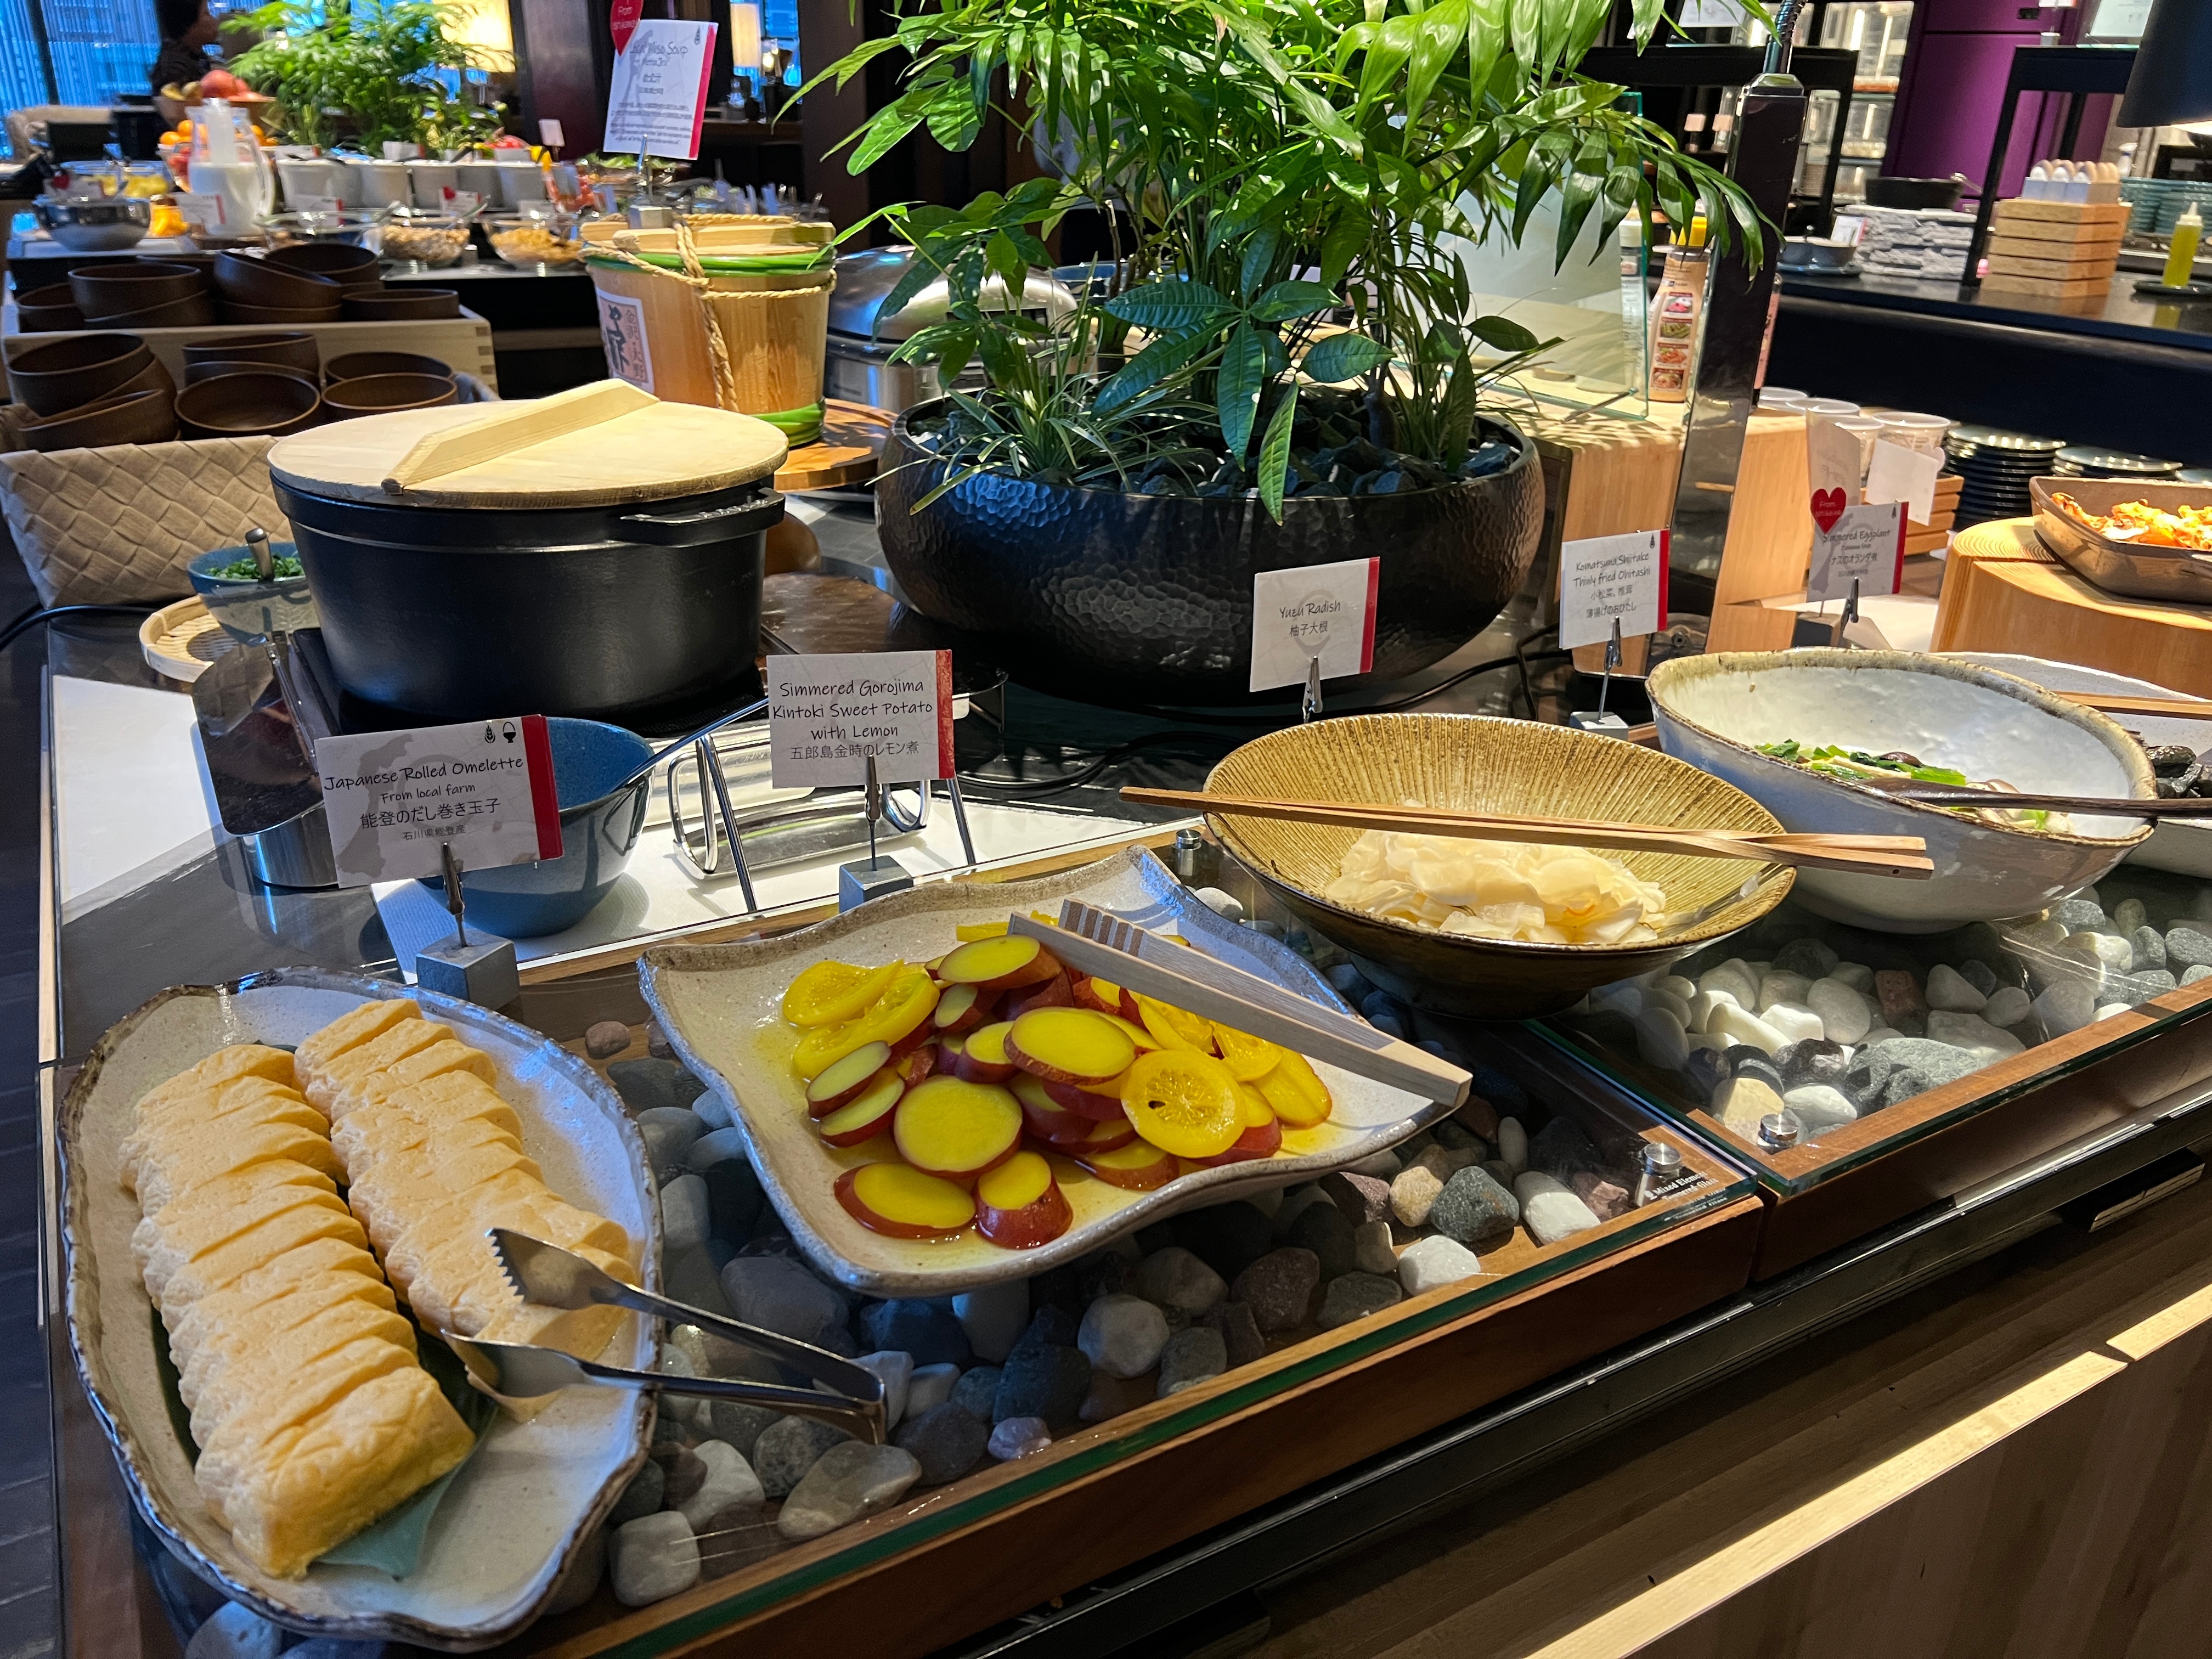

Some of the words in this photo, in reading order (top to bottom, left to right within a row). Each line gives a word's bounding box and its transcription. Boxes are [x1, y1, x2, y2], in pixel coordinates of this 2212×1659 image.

[667, 41, 688, 59] Soup
[1822, 529, 1858, 543] Simmered
[1859, 528, 1891, 542] Eggplant
[1573, 575, 1596, 587] Thinly
[1598, 571, 1616, 585] fried
[1618, 566, 1651, 580] Ohitashi
[1279, 606, 1304, 618] Yuzu
[1305, 600, 1341, 616] Radish
[1289, 620, 1328, 637] 柚子大根
[780, 679, 854, 697] Simmered
[859, 679, 924, 697] Gorojima
[772, 704, 824, 719] Kintoki
[830, 703, 878, 717] Sweet
[881, 701, 933, 715] Potato
[810, 725, 846, 740] with
[853, 725, 898, 738] Lemon
[790, 741, 919, 760] 五郎島金時のレモン煮
[324, 771, 398, 791] Japanese
[399, 762, 447, 781] Rolled
[452, 757, 524, 775] Omelette
[380, 792, 413, 804] From
[416, 785, 442, 799] local
[445, 783, 476, 796] farm
[360, 797, 501, 830] 能登のだし巻き玉子
[402, 823, 466, 841] 石川県能登産
[1652, 1182, 1679, 1196] Mixed
[1675, 1170, 1708, 1187] Element
[1696, 1177, 1719, 1189] Glass
